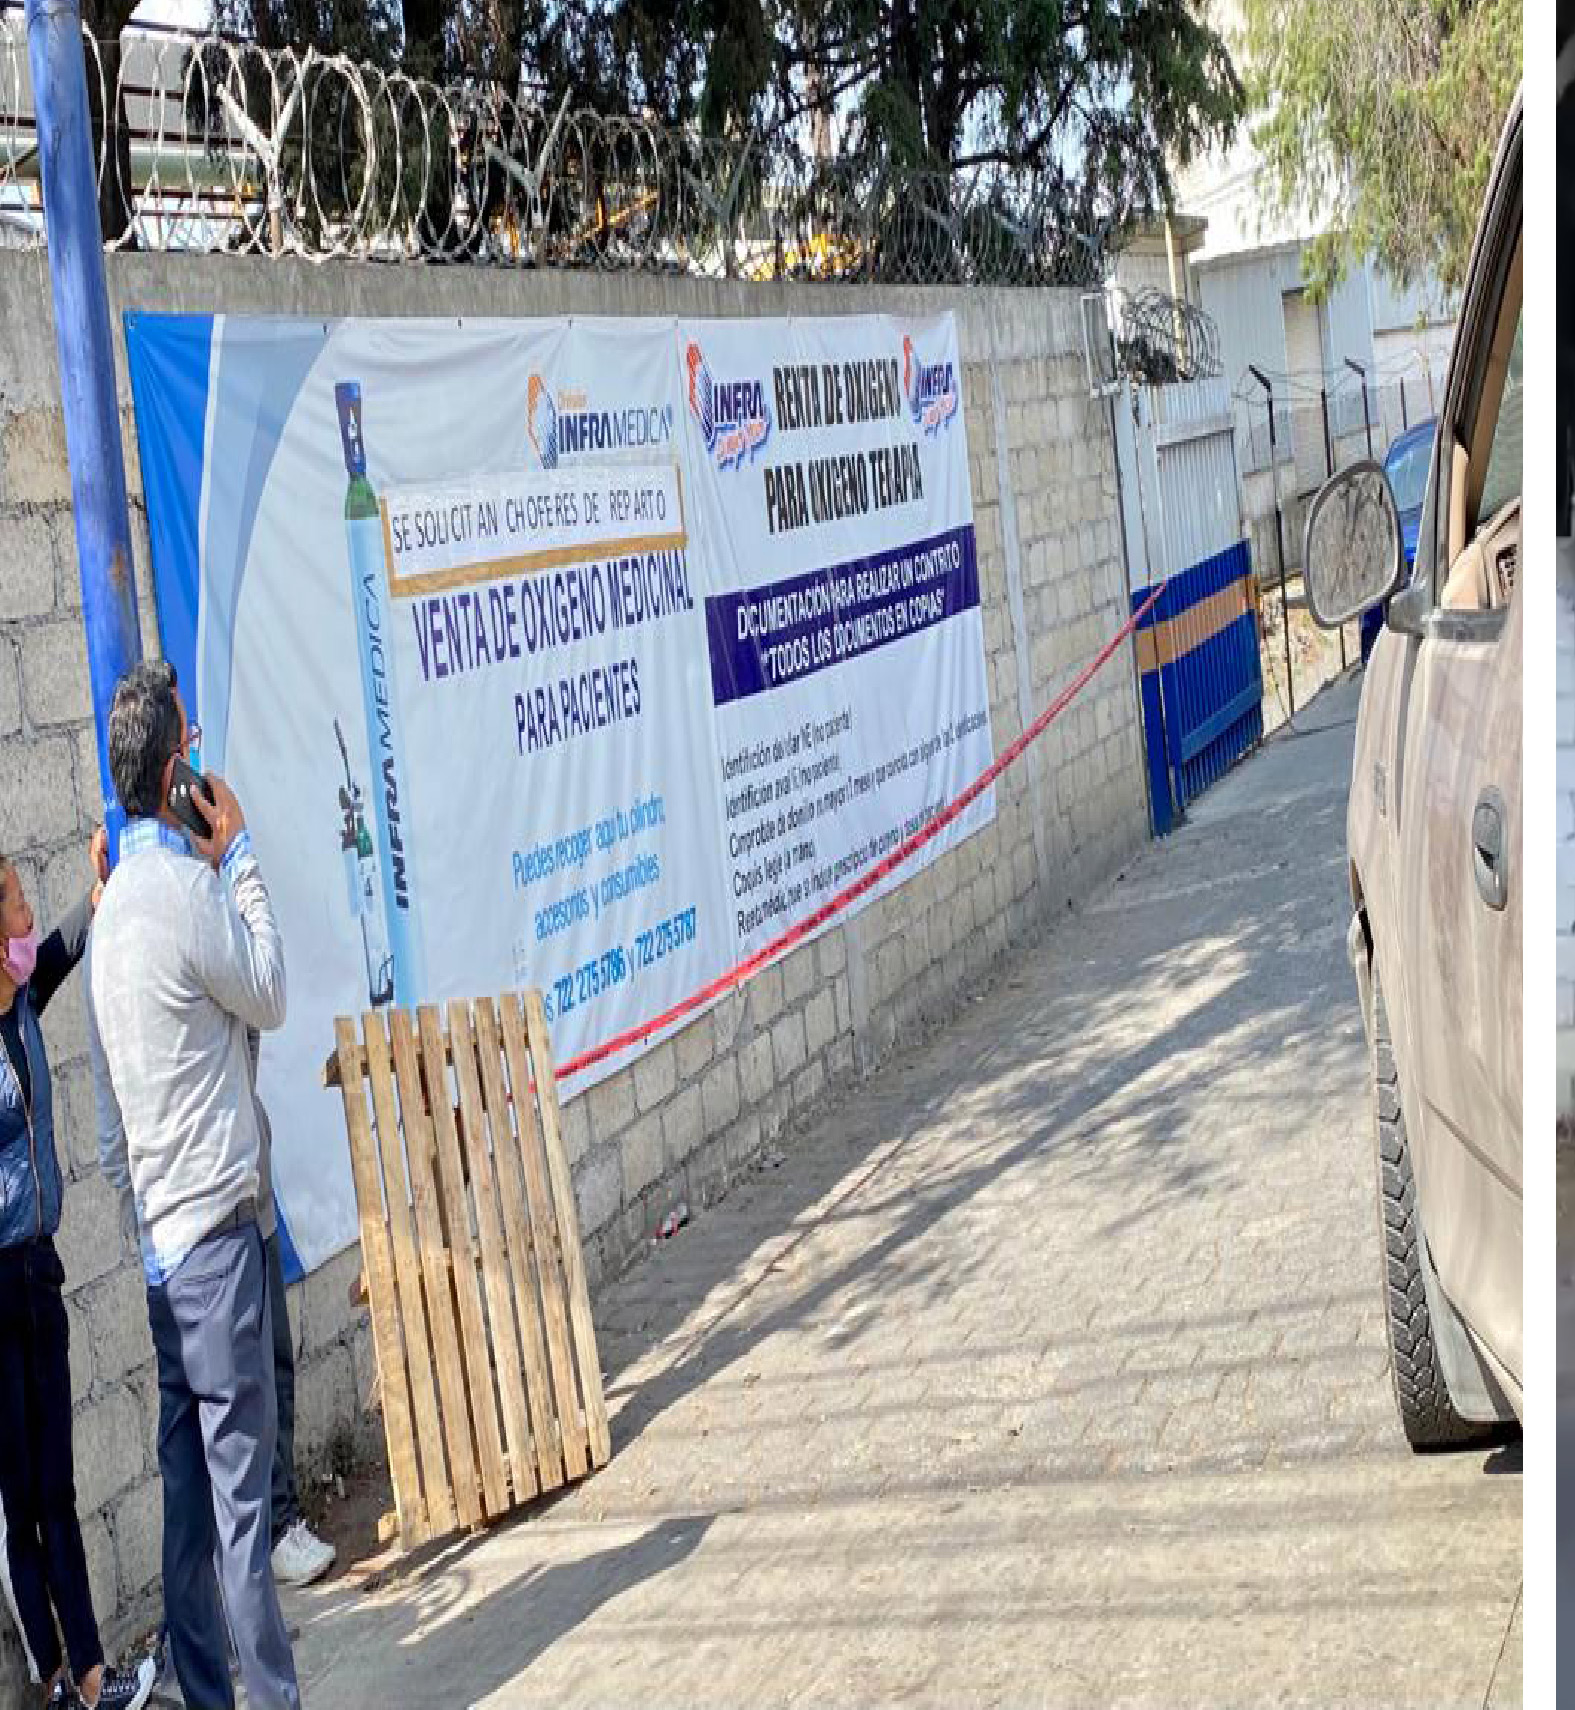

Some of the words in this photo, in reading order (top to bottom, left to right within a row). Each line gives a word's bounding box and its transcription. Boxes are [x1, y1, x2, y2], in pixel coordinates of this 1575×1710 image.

[713, 380, 764, 423] INFRA
[773, 364, 822, 430] RENTA
[822, 362, 843, 425] DE
[843, 358, 901, 423] OXIGENO
[392, 513, 412, 553] SE
[506, 494, 578, 533] CHOFERES
[583, 492, 600, 524] DE
[764, 463, 809, 535] PARA
[808, 451, 869, 524] OXIGENO
[869, 442, 924, 511] TERAPIA
[412, 592, 491, 681] VENTA
[489, 584, 521, 662] DE
[520, 564, 607, 654] OXIGENO
[607, 546, 694, 629] MEDICINAL
[737, 578, 831, 641] DCUMENTACIÓN
[856, 560, 900, 601] REALIZAR
[900, 557, 914, 589] UN
[811, 626, 832, 668] LOS
[896, 600, 908, 634] EN
[514, 683, 562, 756] PARA
[558, 656, 641, 740] PACIENTES
[512, 838, 555, 888] Puedes
[601, 853, 660, 908] consumibles
[553, 973, 576, 1018] 722
[576, 960, 600, 1003] 275
[634, 929, 655, 971] 722
[655, 919, 672, 958] 275
